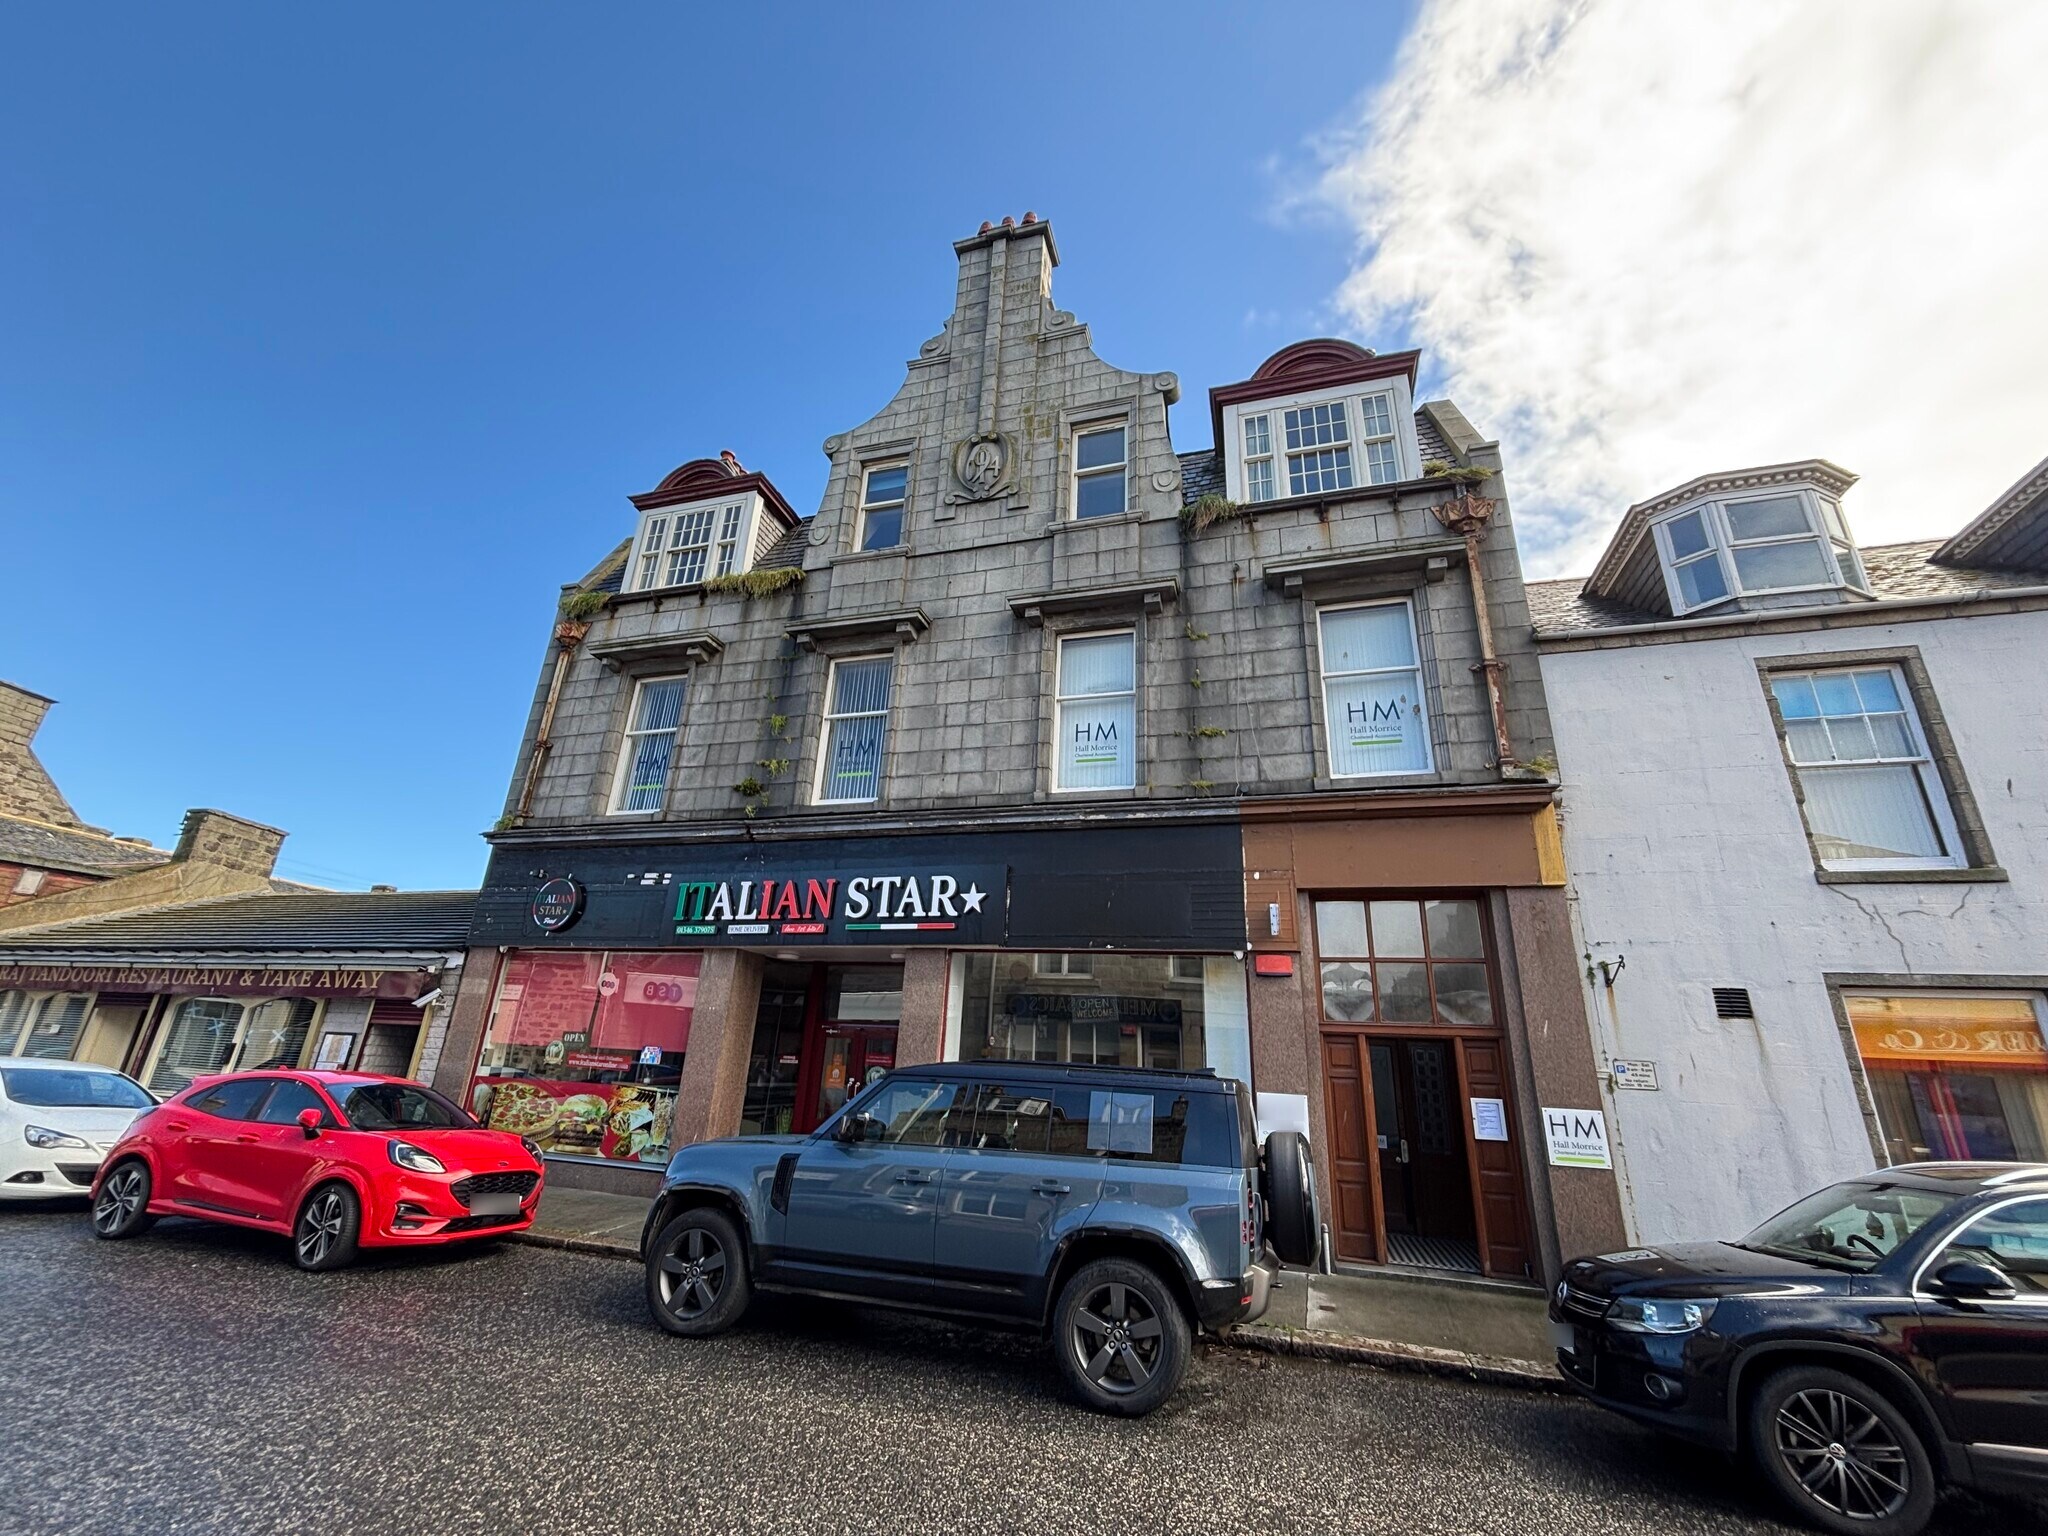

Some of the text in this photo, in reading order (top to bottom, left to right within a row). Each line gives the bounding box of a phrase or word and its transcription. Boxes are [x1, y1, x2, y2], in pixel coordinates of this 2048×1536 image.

[1347, 699, 1401, 723] HM
[1075, 720, 1118, 742] HM
[1350, 724, 1402, 734] Hall Morrice
[839, 739, 875, 757] HM
[538, 894, 573, 904] ITALIAN
[672, 875, 959, 921] ITALIAN STAR
[538, 905, 562, 915] STAR
[729, 925, 768, 934] HOME DELIVERY
[29, 966, 113, 984] TANDOORI
[115, 967, 237, 986] RESTAURANT
[239, 970, 255, 986] &
[259, 970, 314, 987] TAKE
[315, 970, 384, 989] AWAY
[1079, 998, 1110, 1010] OPEN
[1075, 1008, 1115, 1019] WELCOME
[564, 1032, 587, 1042] OPEN
[1548, 1114, 1602, 1139] HM
[1552, 1140, 1603, 1151] Hall Morrice
